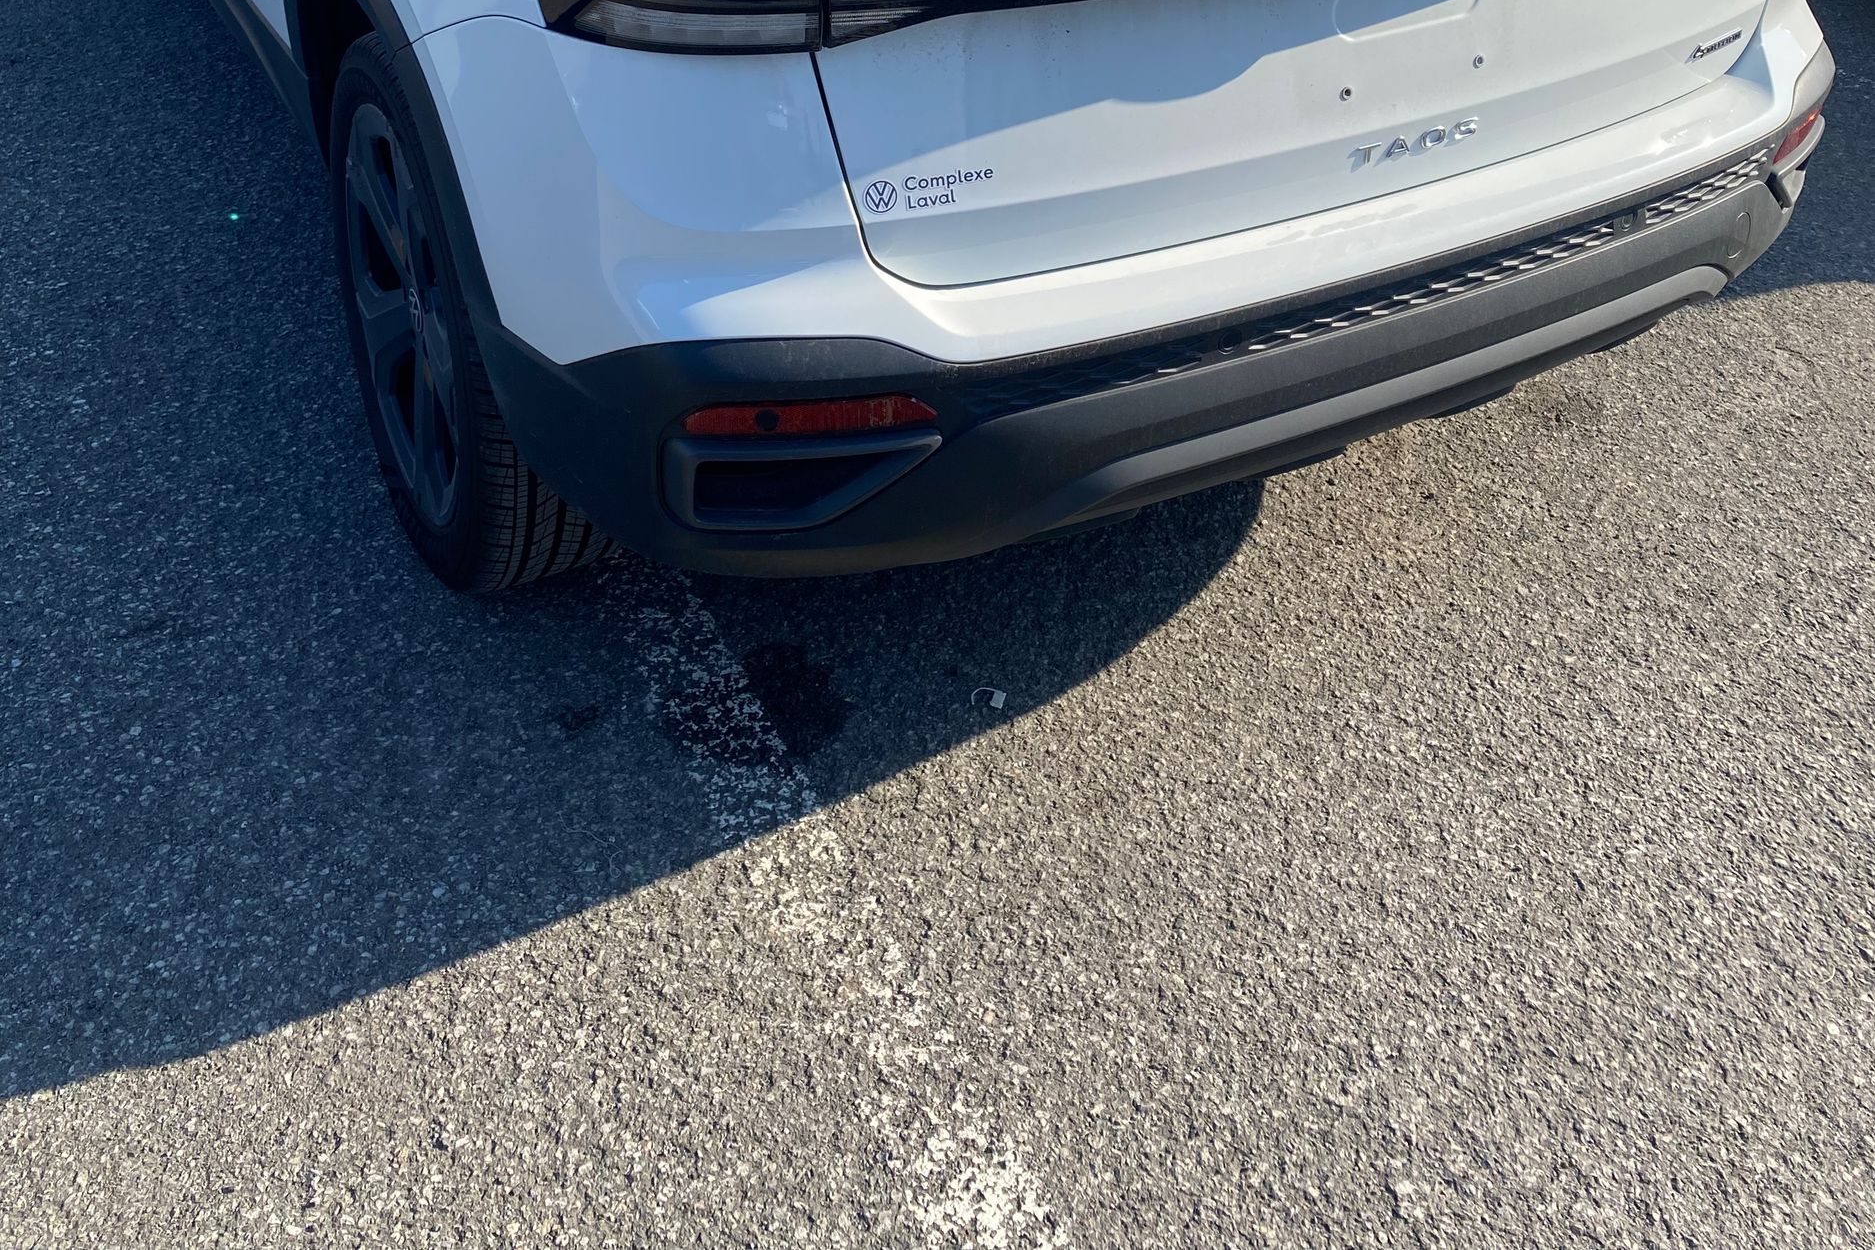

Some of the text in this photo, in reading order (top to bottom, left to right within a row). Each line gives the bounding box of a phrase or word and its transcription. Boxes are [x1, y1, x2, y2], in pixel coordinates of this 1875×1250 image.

[1358, 116, 1479, 164] TAOS
[904, 168, 994, 191] Complexe
[906, 189, 956, 209] Laval
